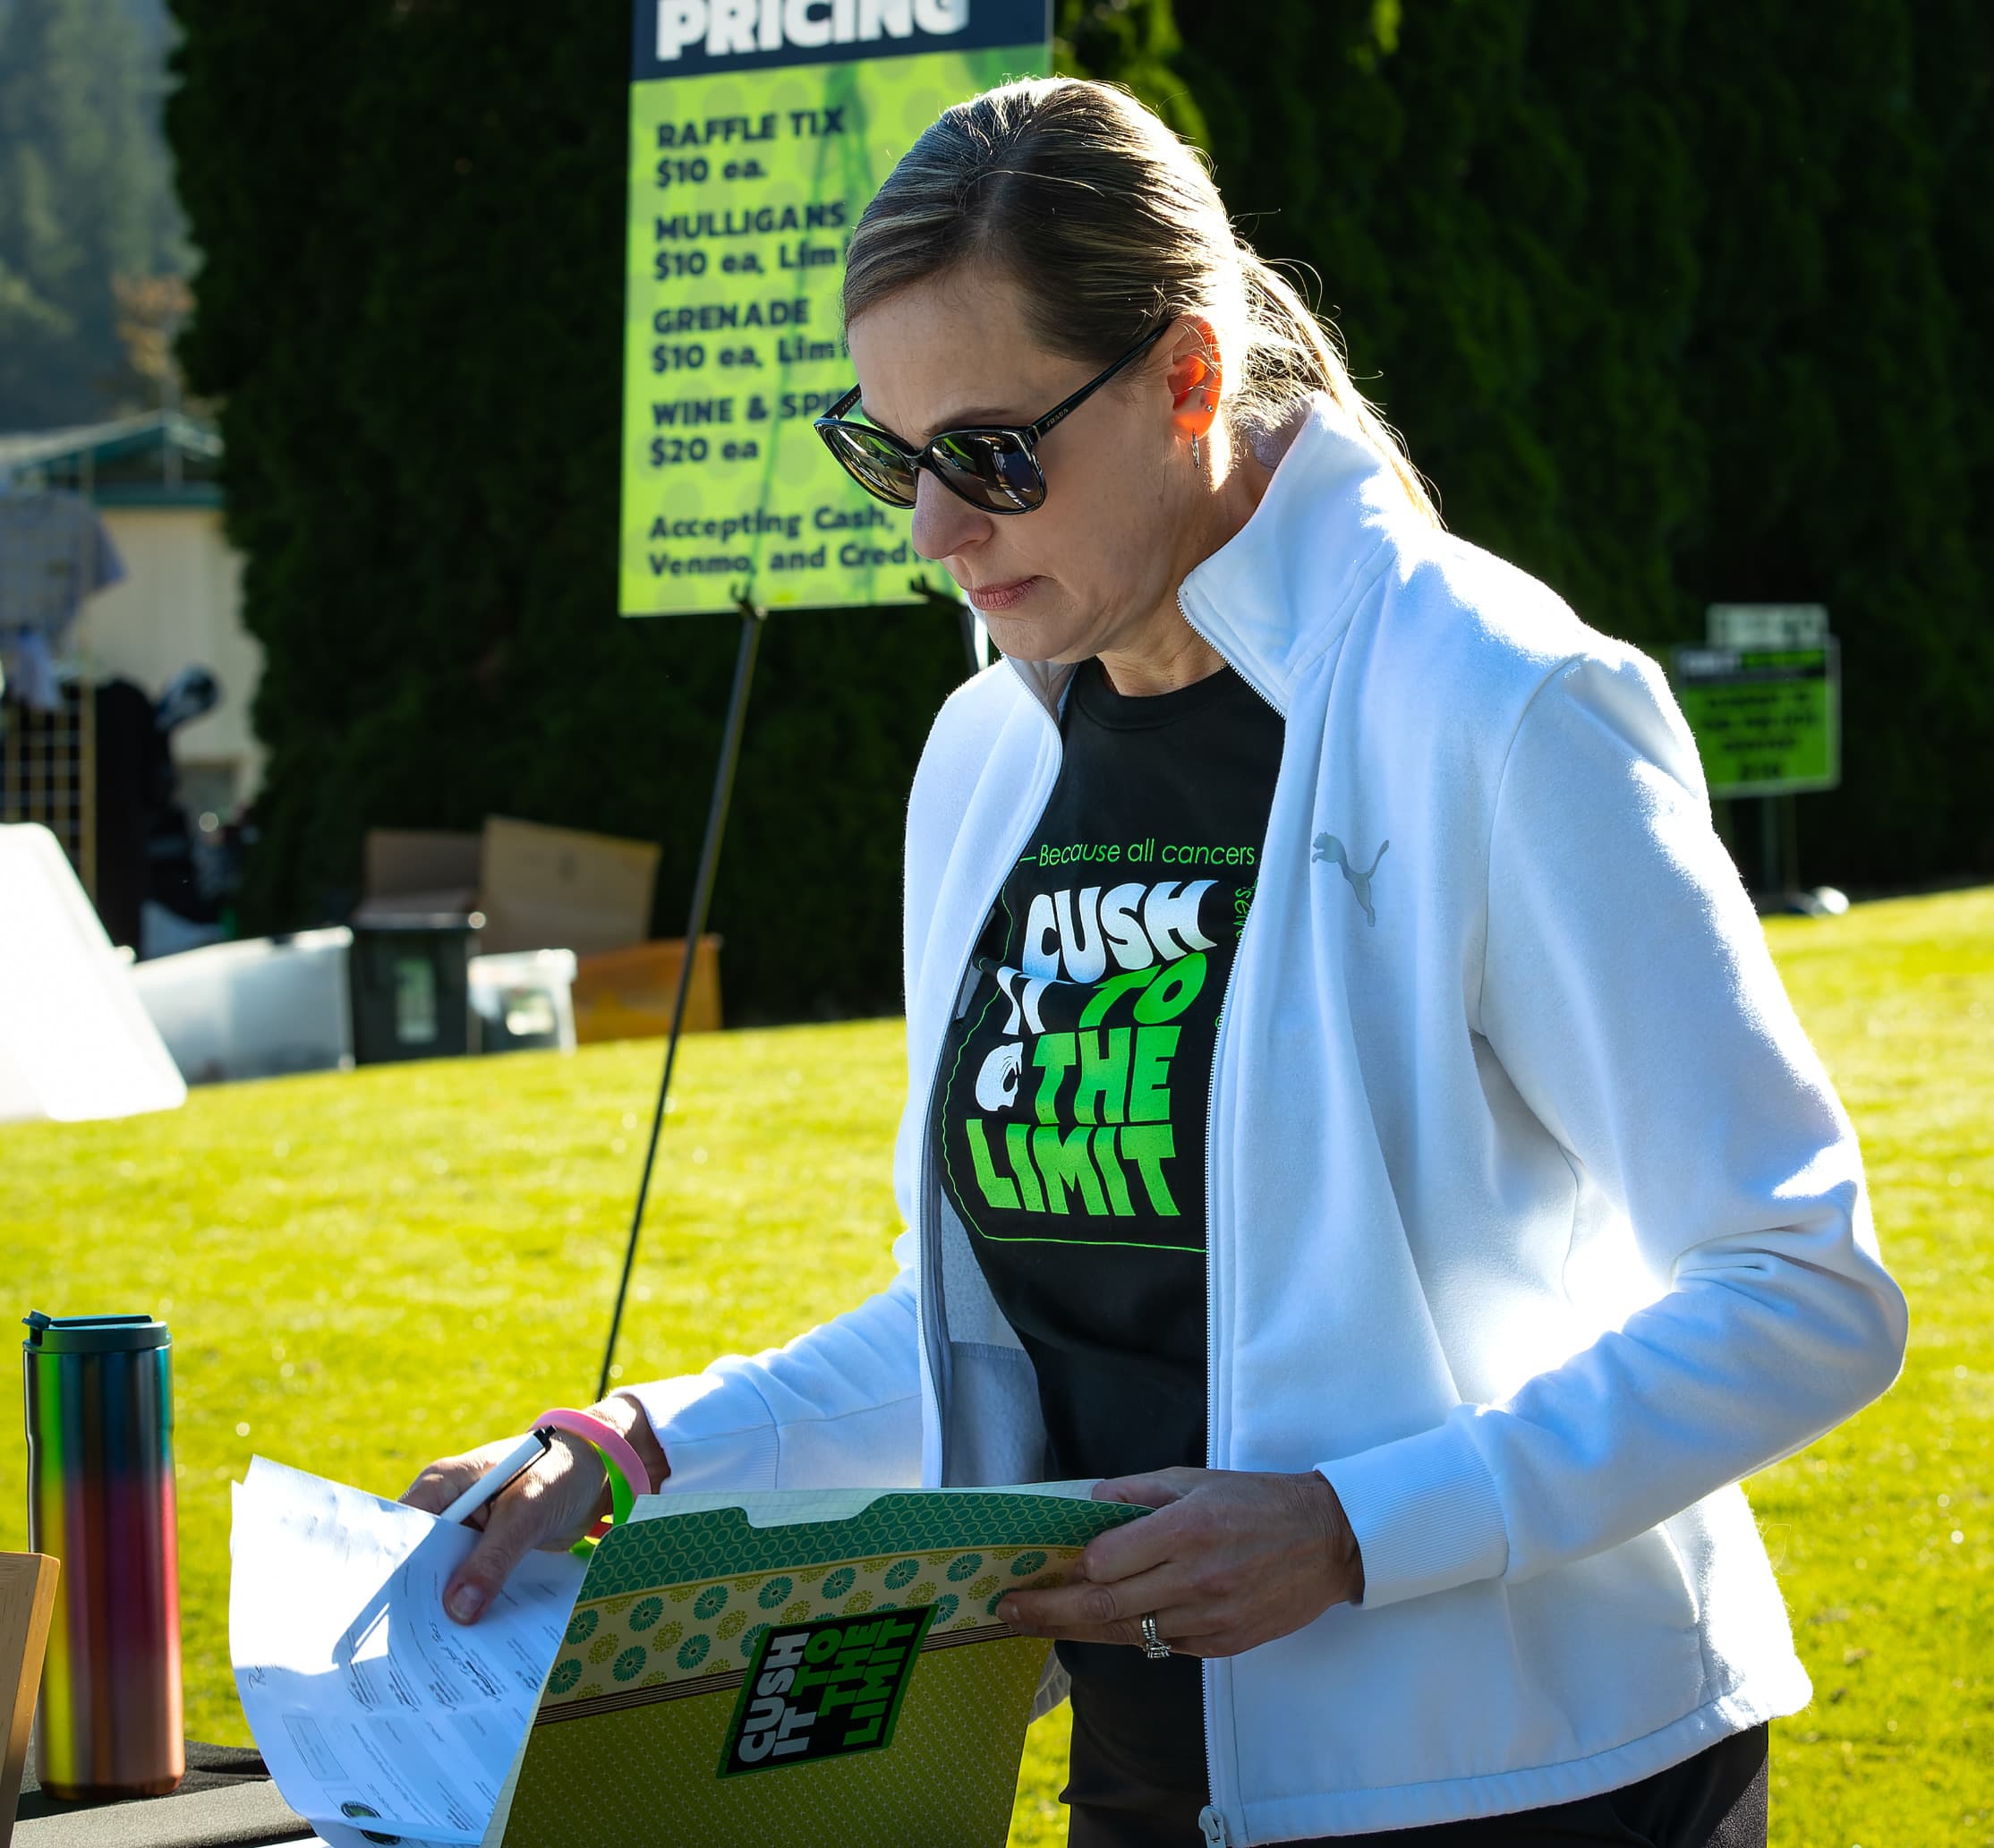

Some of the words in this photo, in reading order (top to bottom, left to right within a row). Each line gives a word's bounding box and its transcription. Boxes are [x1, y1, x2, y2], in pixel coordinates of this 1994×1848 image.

[656, 0, 969, 61] PRICING
[658, 115, 776, 149] RAFFLE
[788, 106, 844, 137] TIX
[655, 157, 709, 189] $10
[722, 158, 768, 180] ea.
[656, 201, 847, 243] MULLIGANS
[654, 250, 707, 282] $10
[652, 298, 810, 335] GRENADE
[652, 343, 705, 375] $10
[652, 396, 733, 428] WINE
[746, 394, 769, 421] &
[650, 438, 709, 468] $20
[721, 439, 758, 461] ea
[649, 509, 801, 541] Accepting
[814, 504, 894, 532] Cash,
[648, 550, 755, 577] Venmo,
[769, 543, 826, 570] and
[1038, 841, 1121, 866] Because
[1128, 838, 1155, 863] all
[1162, 842, 1256, 865] cancers
[1022, 880, 1219, 984] CUSH
[996, 966, 1061, 1035] IT
[1078, 952, 1206, 1028] TO
[1033, 1026, 1182, 1124] THE
[967, 1119, 1181, 1216] LIMIT
[789, 1629, 842, 1698] TO
[818, 1621, 882, 1717] THE
[843, 1618, 916, 1745] LIMIT
[738, 1632, 810, 1763] CUSH
[772, 1707, 817, 1756] IT
